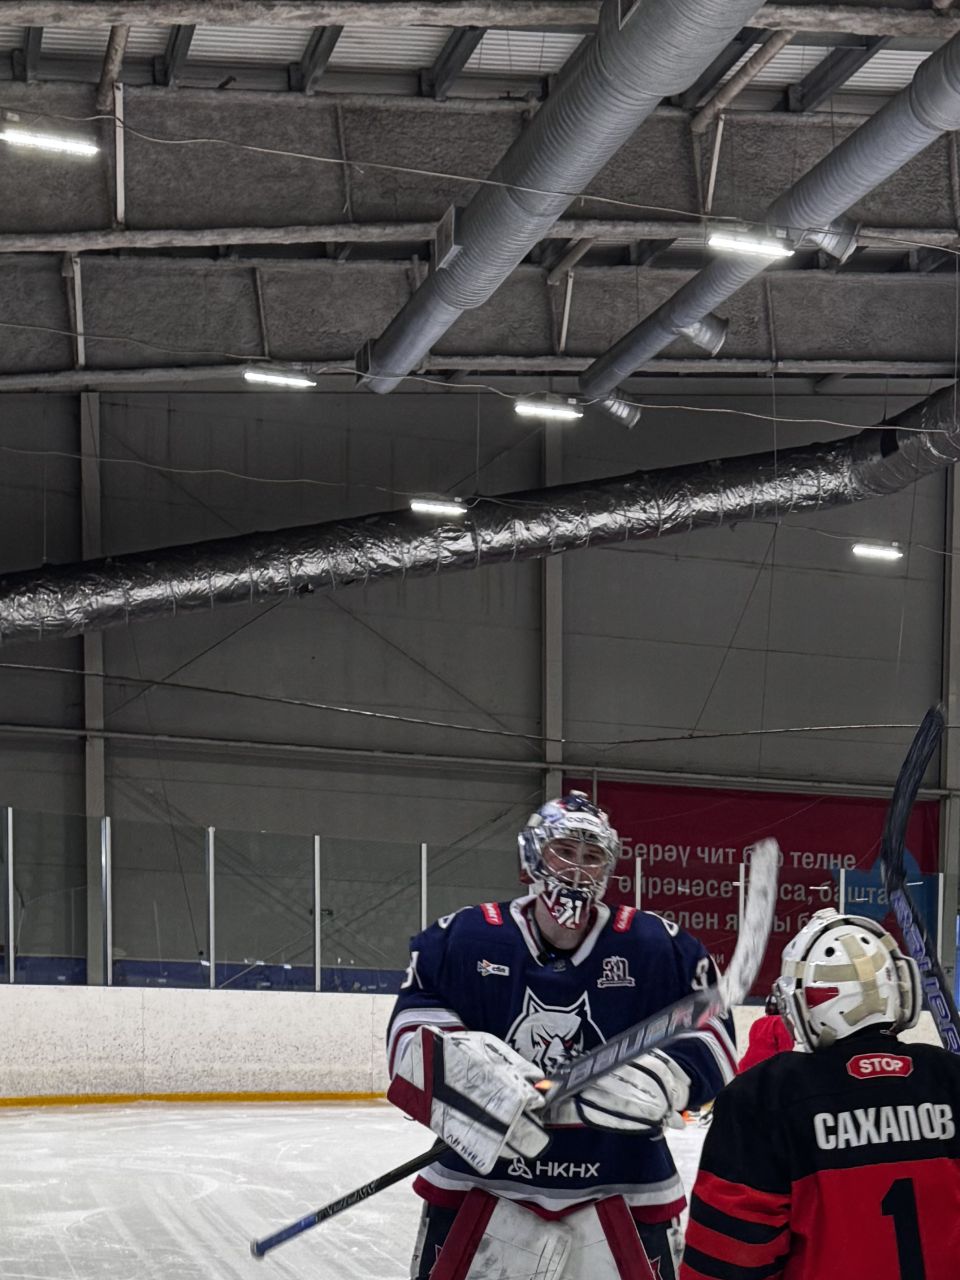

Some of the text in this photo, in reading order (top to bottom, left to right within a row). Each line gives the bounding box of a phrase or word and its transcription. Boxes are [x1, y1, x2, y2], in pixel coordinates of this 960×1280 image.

[695, 845, 737, 866] чит
[789, 849, 857, 871] телне
[859, 1057, 904, 1074] STOP
[813, 1102, 956, 1151] САХАПОВ
